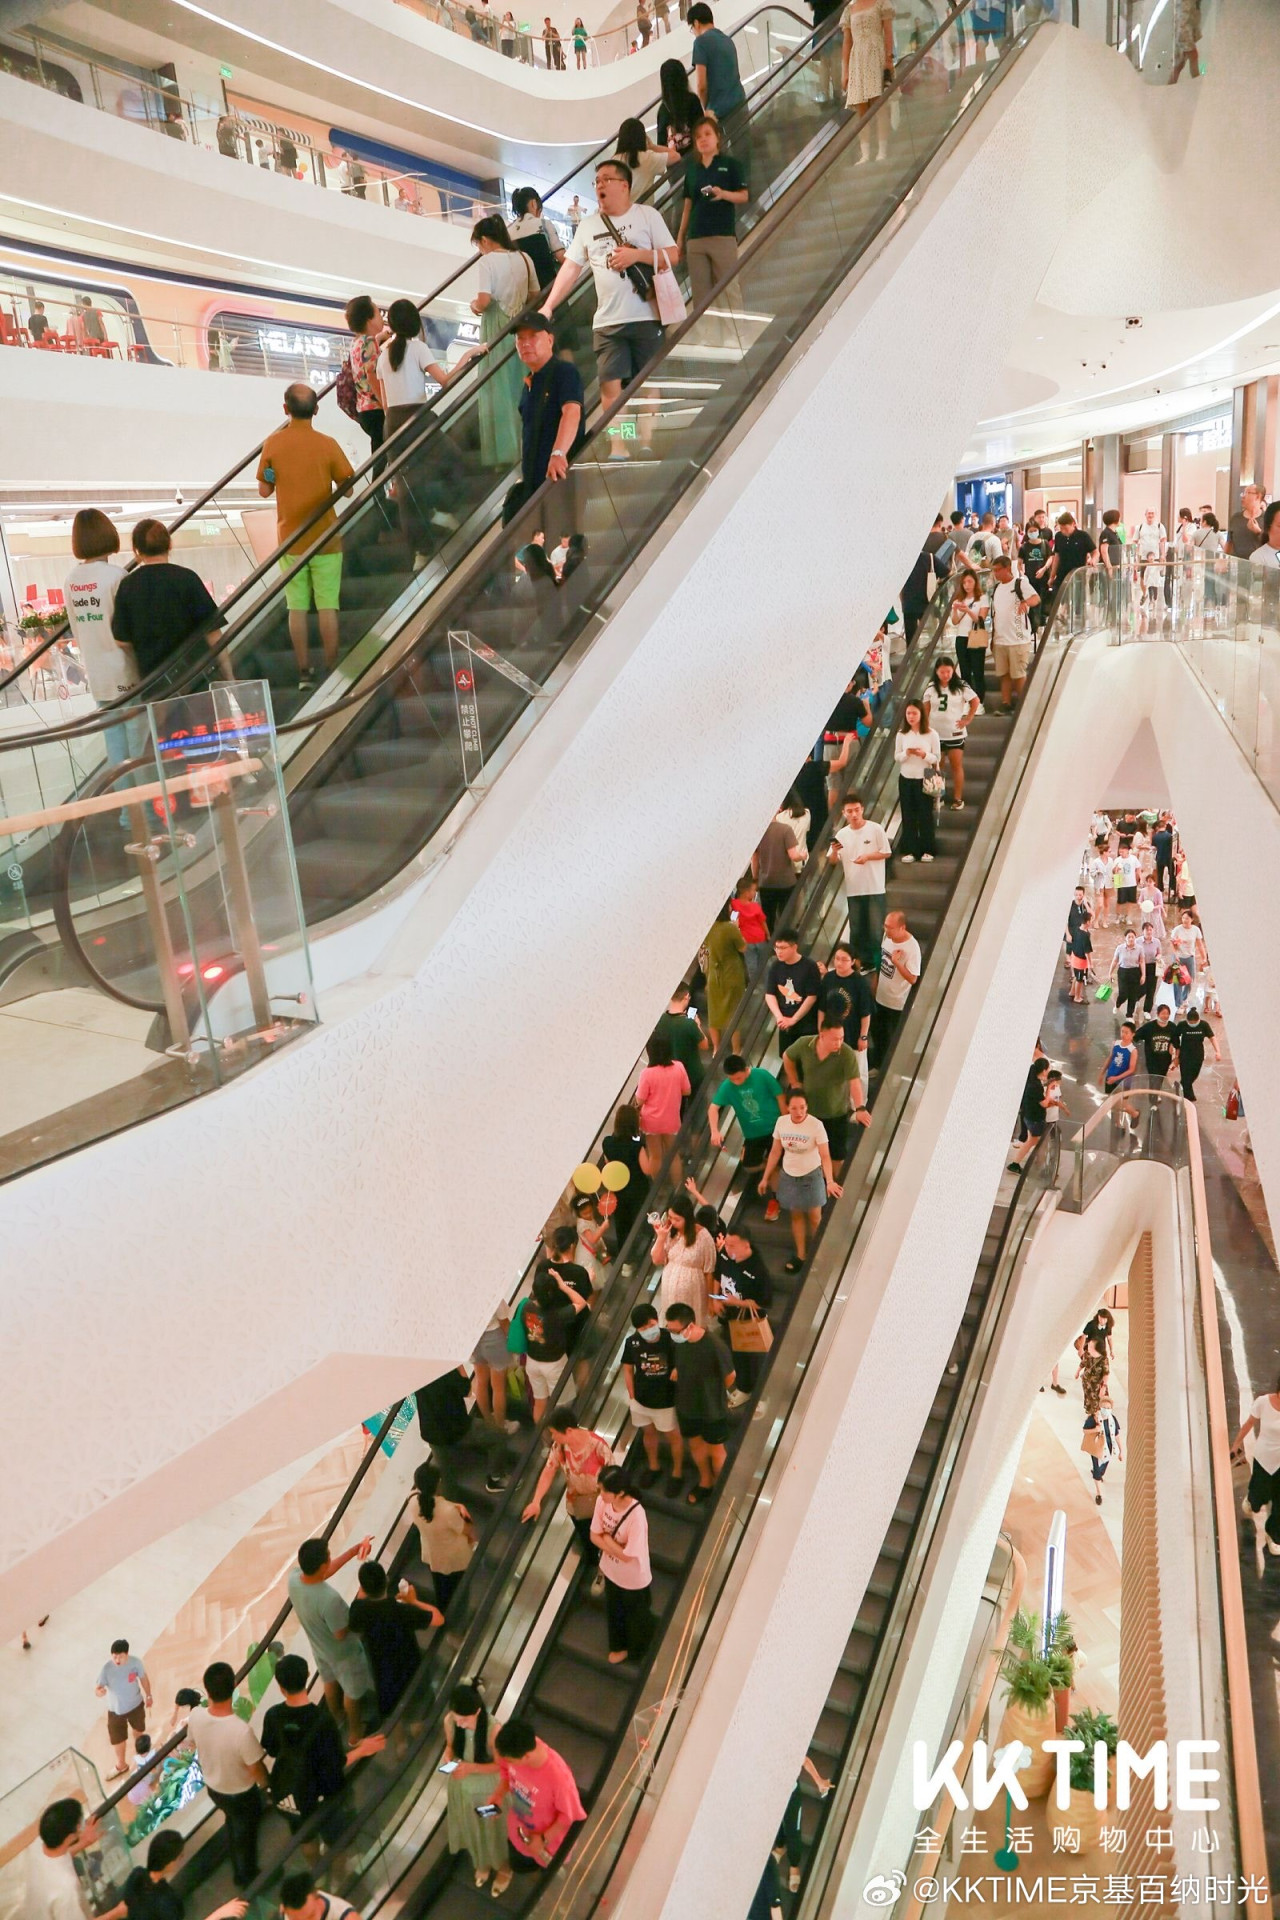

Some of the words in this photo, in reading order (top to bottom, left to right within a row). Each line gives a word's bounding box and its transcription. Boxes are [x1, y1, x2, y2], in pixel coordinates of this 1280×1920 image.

[258, 328, 331, 358] MELAND
[69, 582, 98, 593] Youngs
[73, 597, 89, 608] ade
[90, 596, 101, 608] By
[86, 612, 104, 622] Four
[938, 693, 948, 712] 3
[468, 704, 475, 715] DO
[469, 716, 477, 729] NOT
[471, 730, 479, 752] CLIMB
